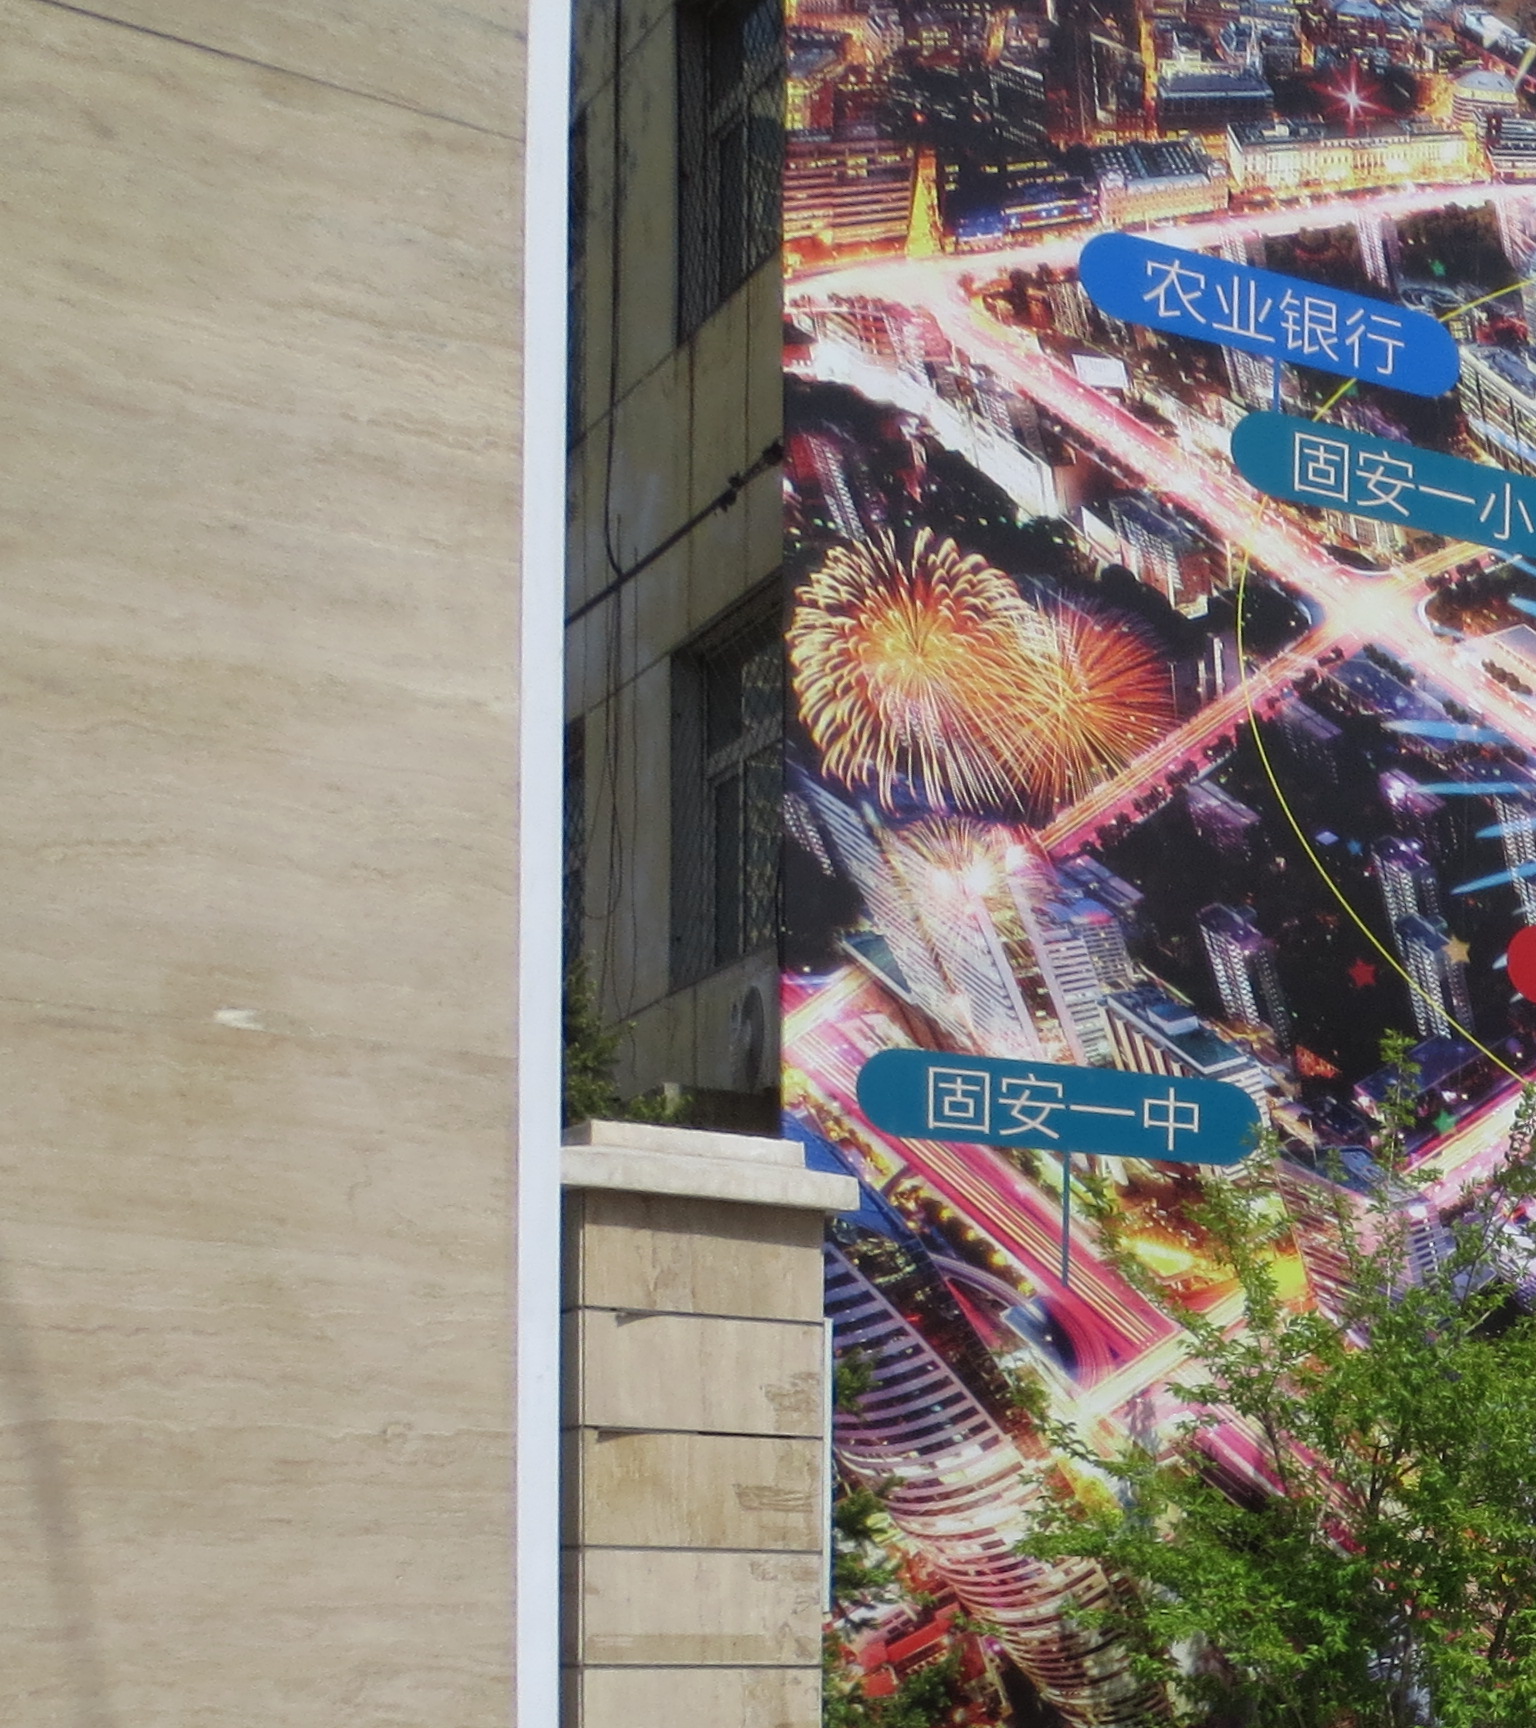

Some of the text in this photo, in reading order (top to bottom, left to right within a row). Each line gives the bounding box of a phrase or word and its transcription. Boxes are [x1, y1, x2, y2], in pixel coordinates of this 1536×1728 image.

[1142, 258, 1406, 379] 农业银行
[1291, 431, 1536, 541] 固安一小
[927, 1065, 1201, 1151] 固安一中
